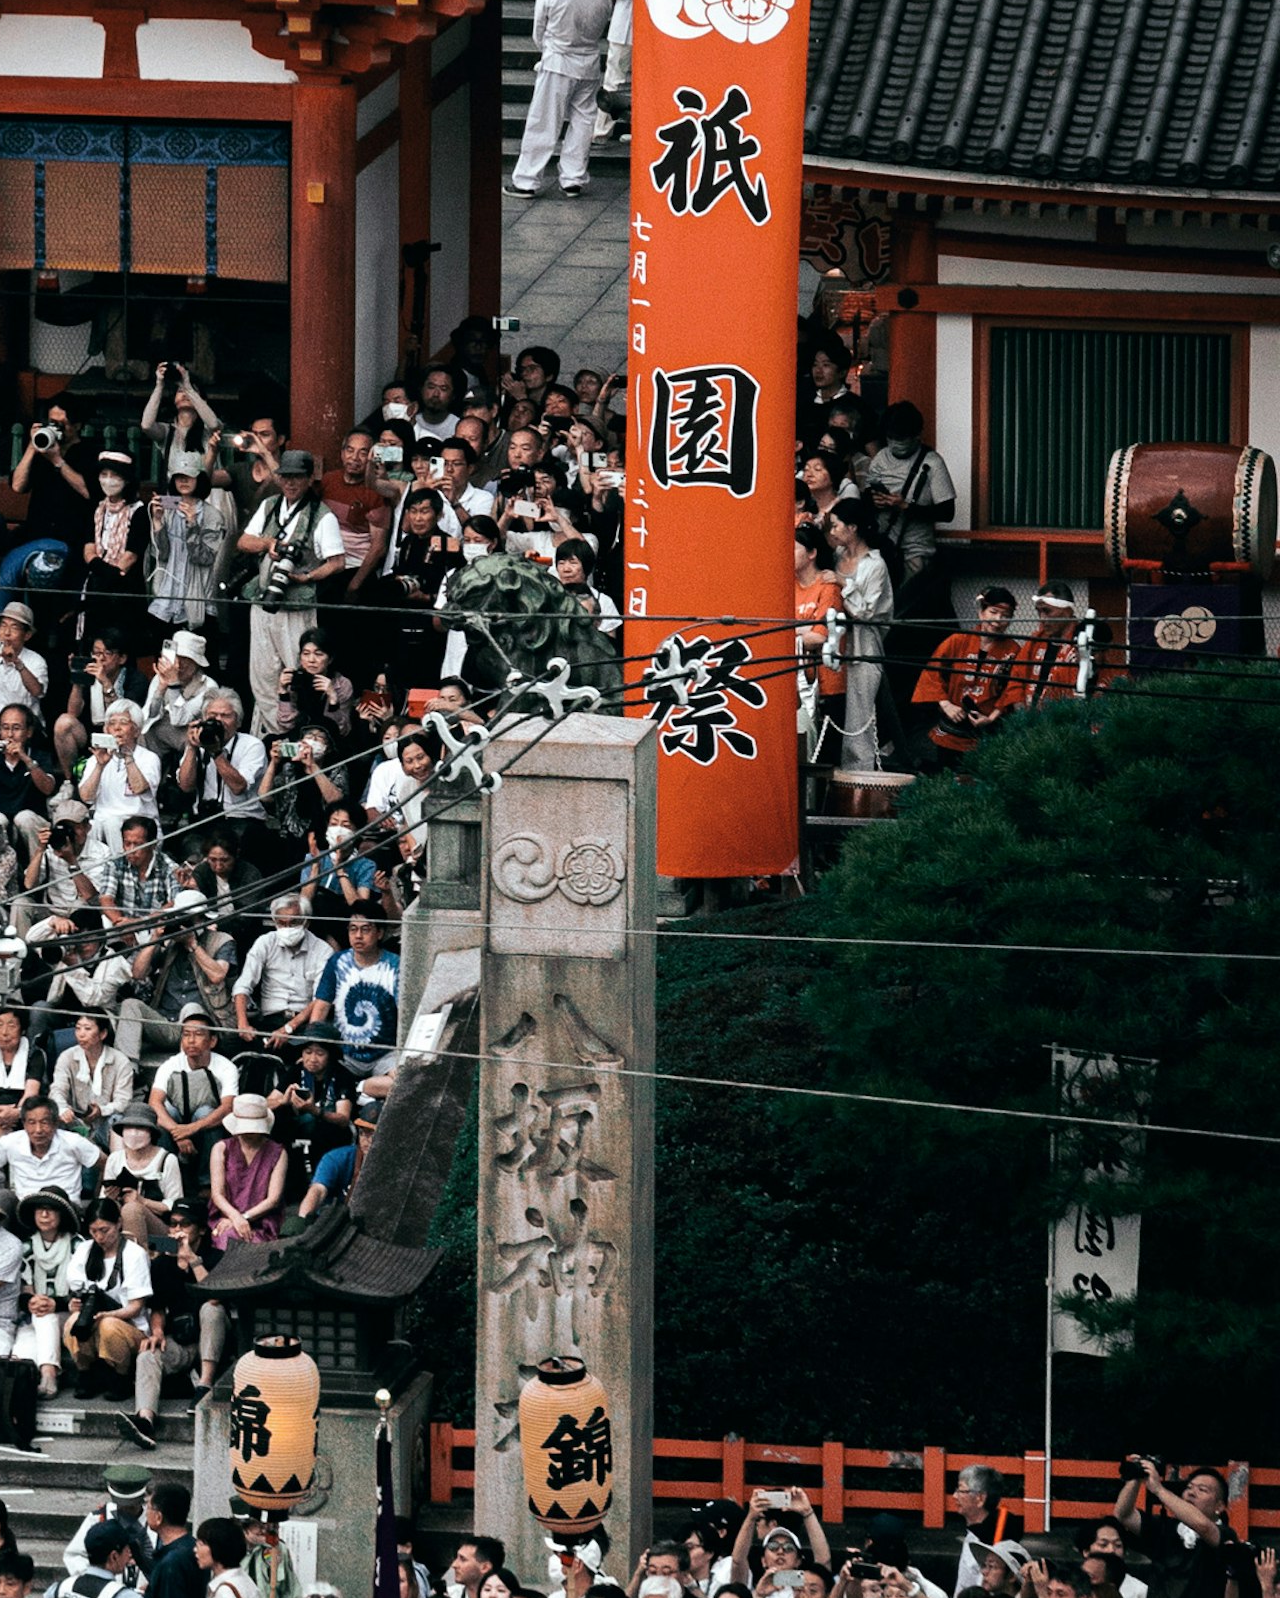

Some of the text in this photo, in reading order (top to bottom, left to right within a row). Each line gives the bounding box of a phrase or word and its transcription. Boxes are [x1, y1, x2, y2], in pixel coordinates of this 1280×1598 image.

[643, 84, 771, 766] 祇園祭
[541, 1405, 612, 1491] 錦
